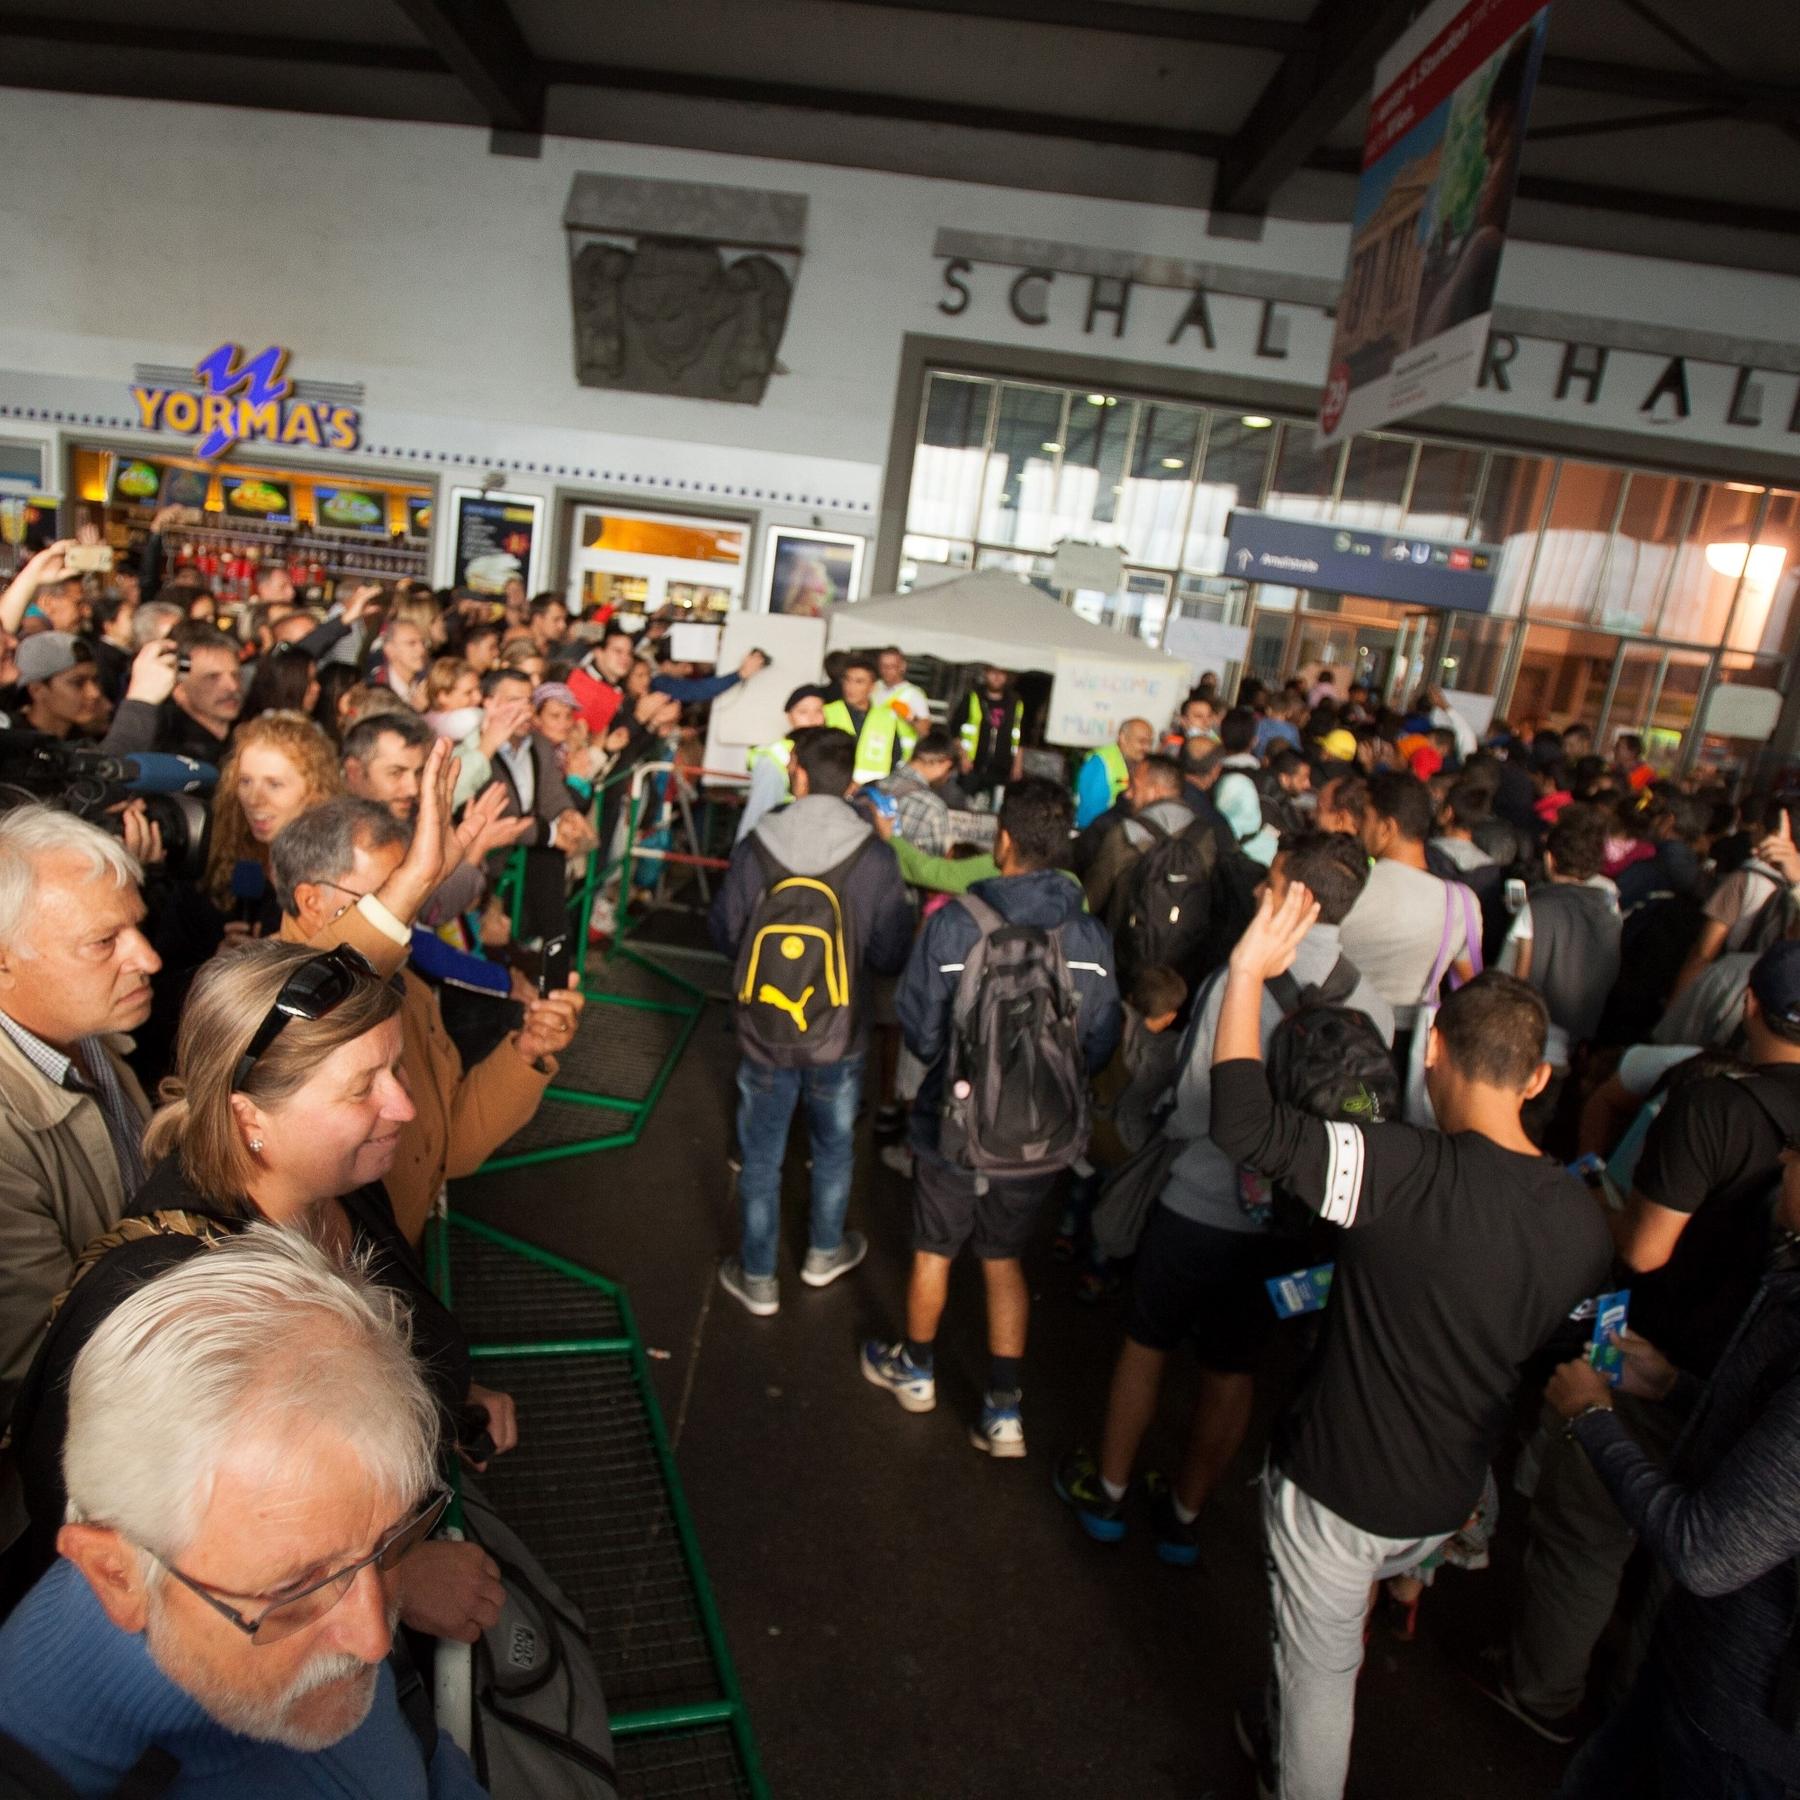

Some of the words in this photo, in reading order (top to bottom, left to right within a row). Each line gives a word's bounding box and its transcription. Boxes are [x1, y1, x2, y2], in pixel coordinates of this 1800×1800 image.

[133, 386, 361, 451] YORMA'S
[1410, 543, 1431, 565] U
[1071, 666, 1162, 697] WELCOME
